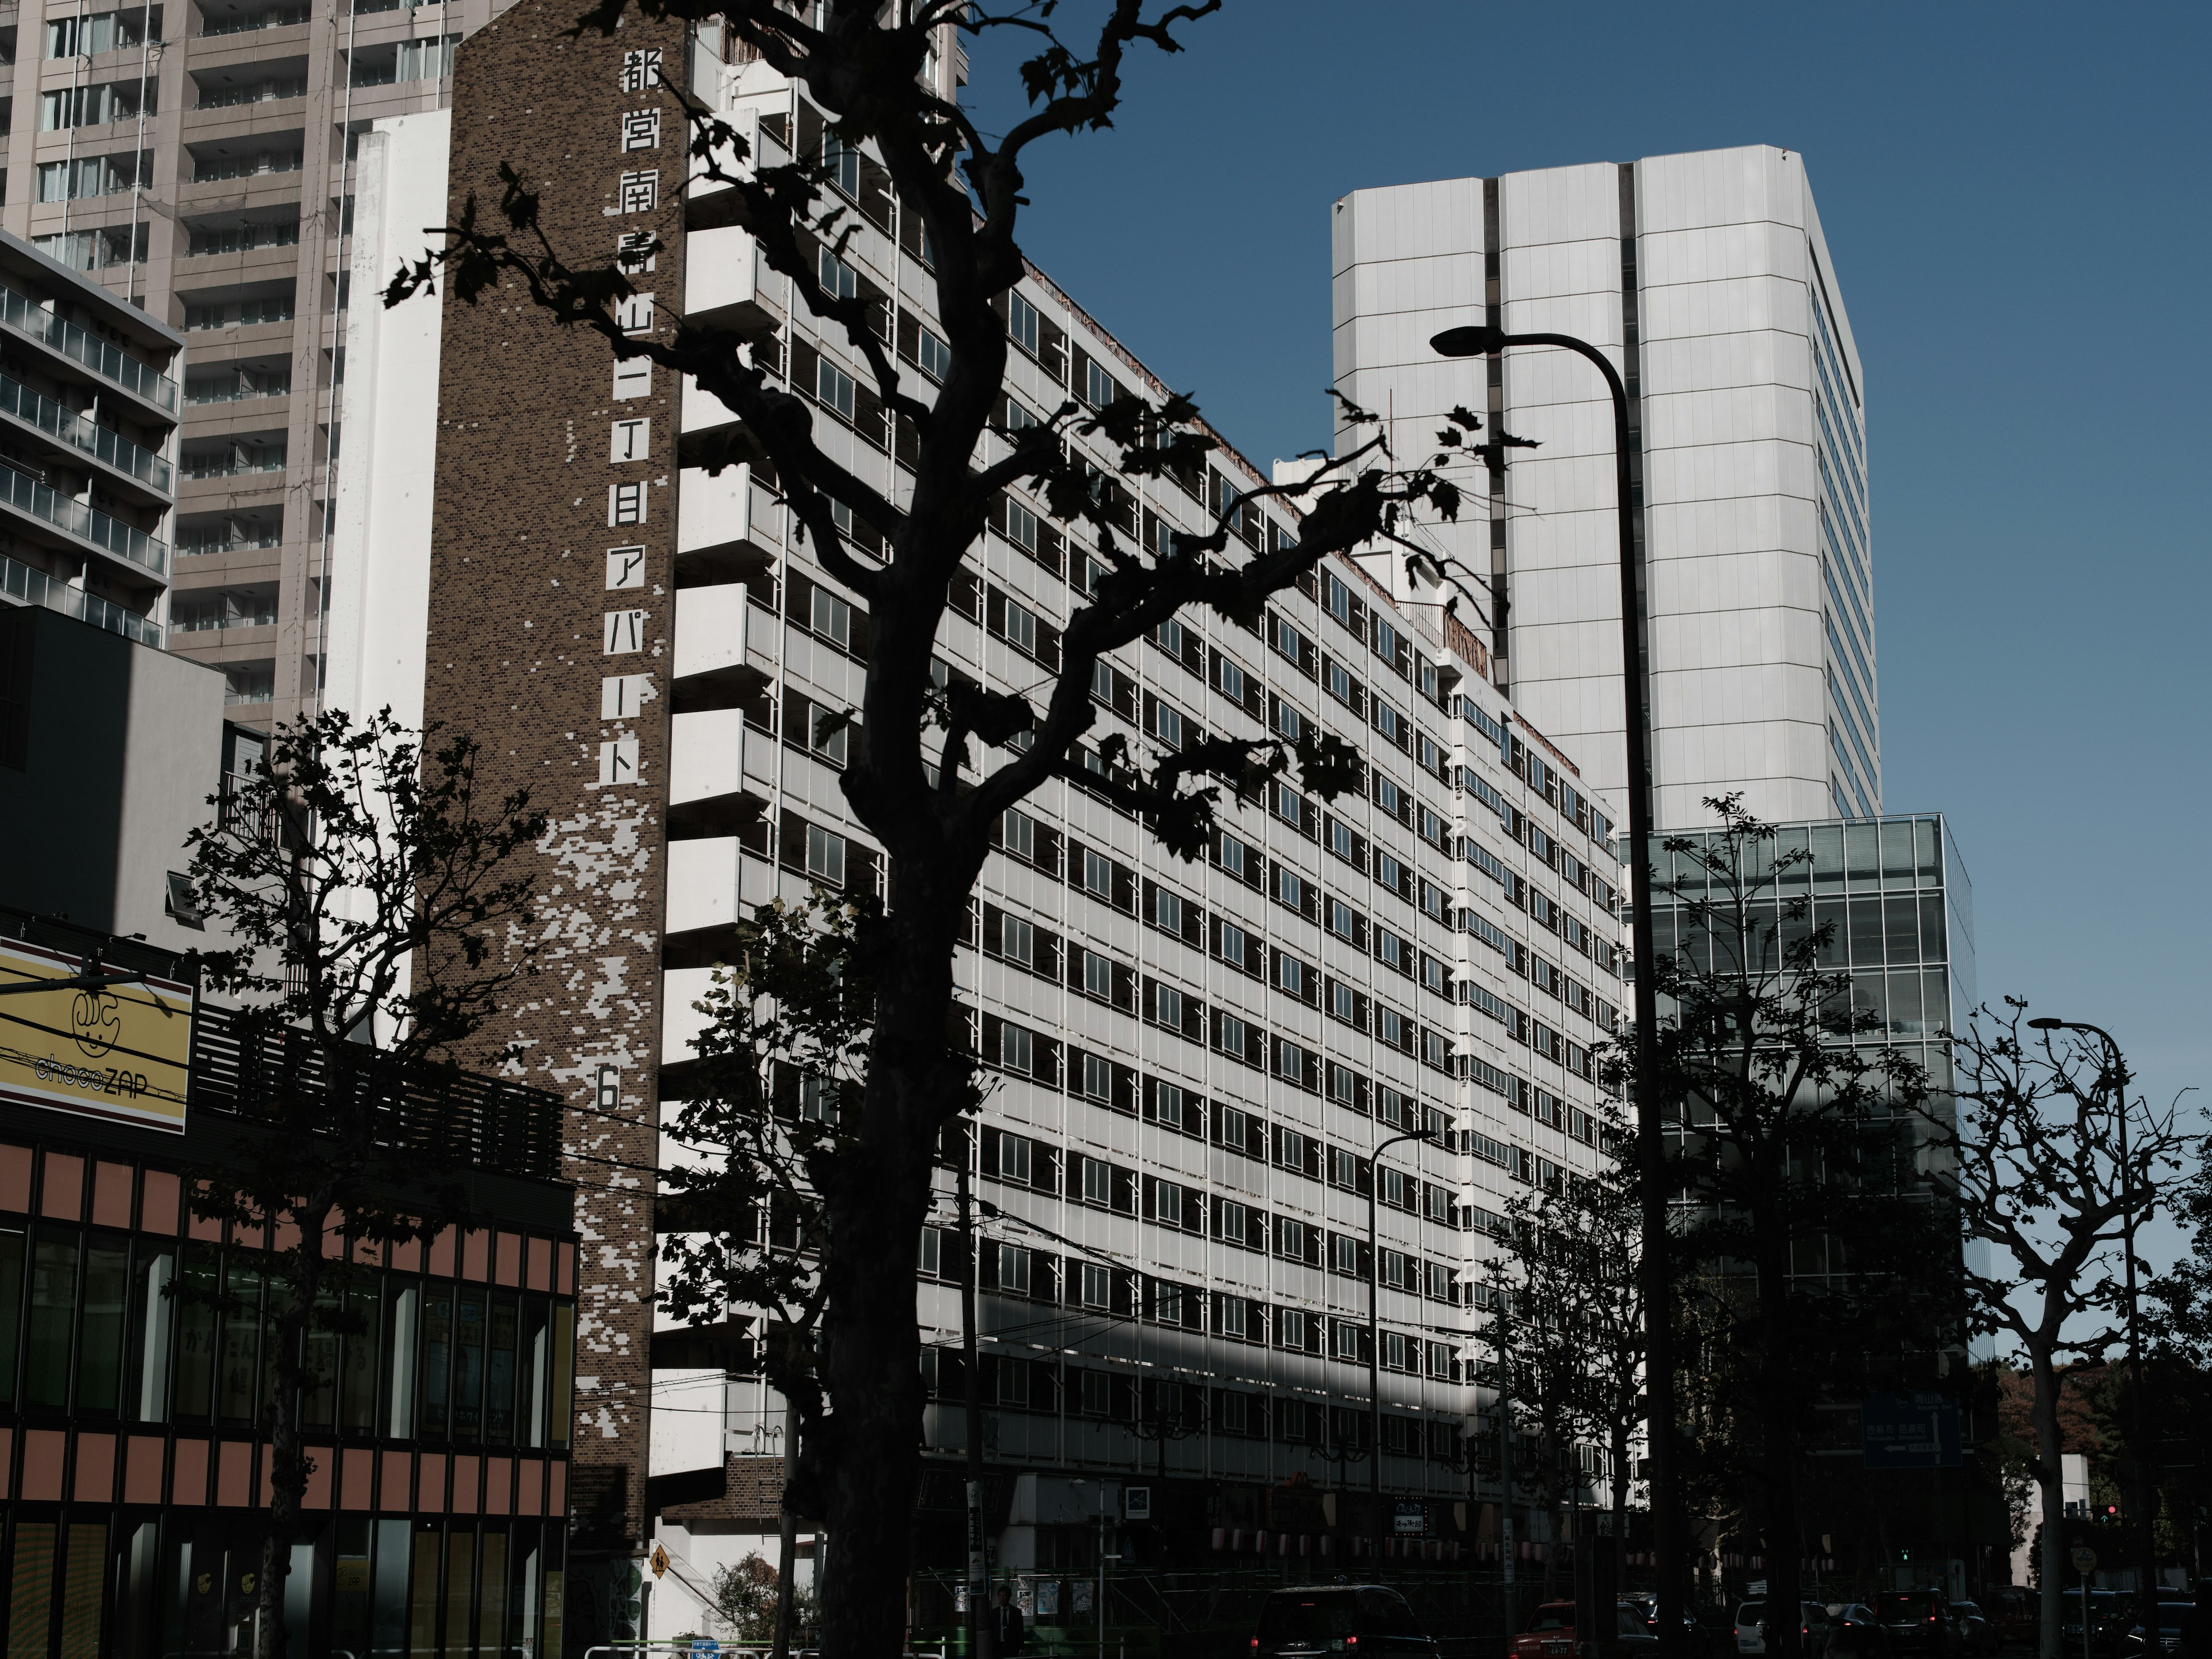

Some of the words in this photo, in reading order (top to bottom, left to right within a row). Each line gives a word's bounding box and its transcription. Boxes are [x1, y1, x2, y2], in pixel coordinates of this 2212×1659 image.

[35, 1054, 148, 1099] chocoZAP
[597, 1065, 619, 1111] 6
[1916, 1392, 1950, 1404] 青山通
[1866, 1425, 1894, 1434] 西麻布
[1899, 1423, 1926, 1434] 信濃町
[348, 1577, 361, 1586] ZAP
